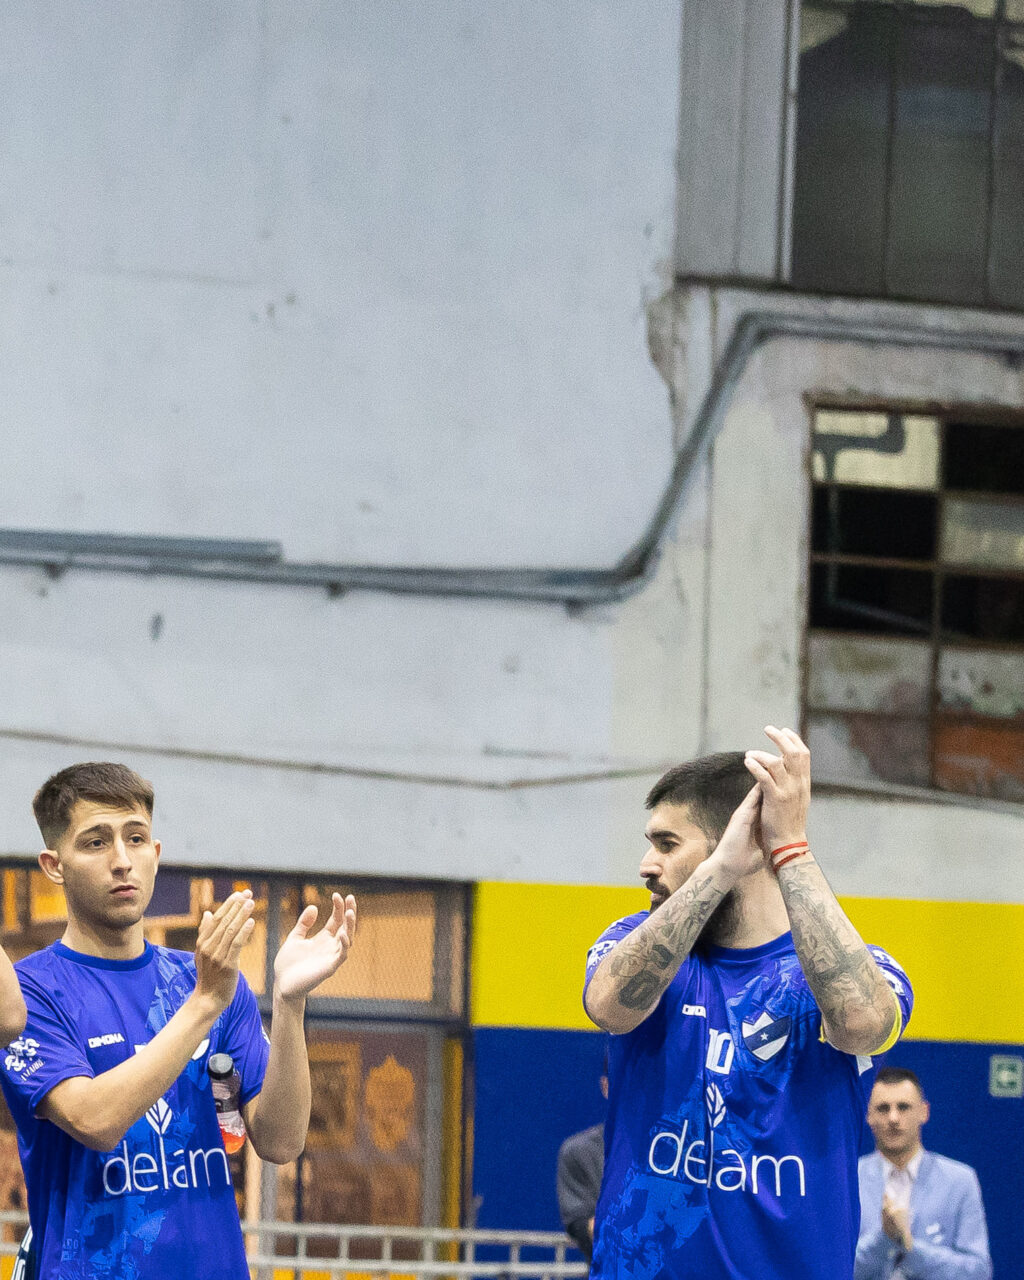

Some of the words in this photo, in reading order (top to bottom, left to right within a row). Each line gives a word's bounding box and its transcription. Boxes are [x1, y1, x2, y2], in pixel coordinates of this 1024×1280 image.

[87, 1032, 125, 1049] DIMONA
[705, 1027, 735, 1075] 10
[102, 1136, 231, 1195] delam
[649, 1119, 806, 1197] delam
